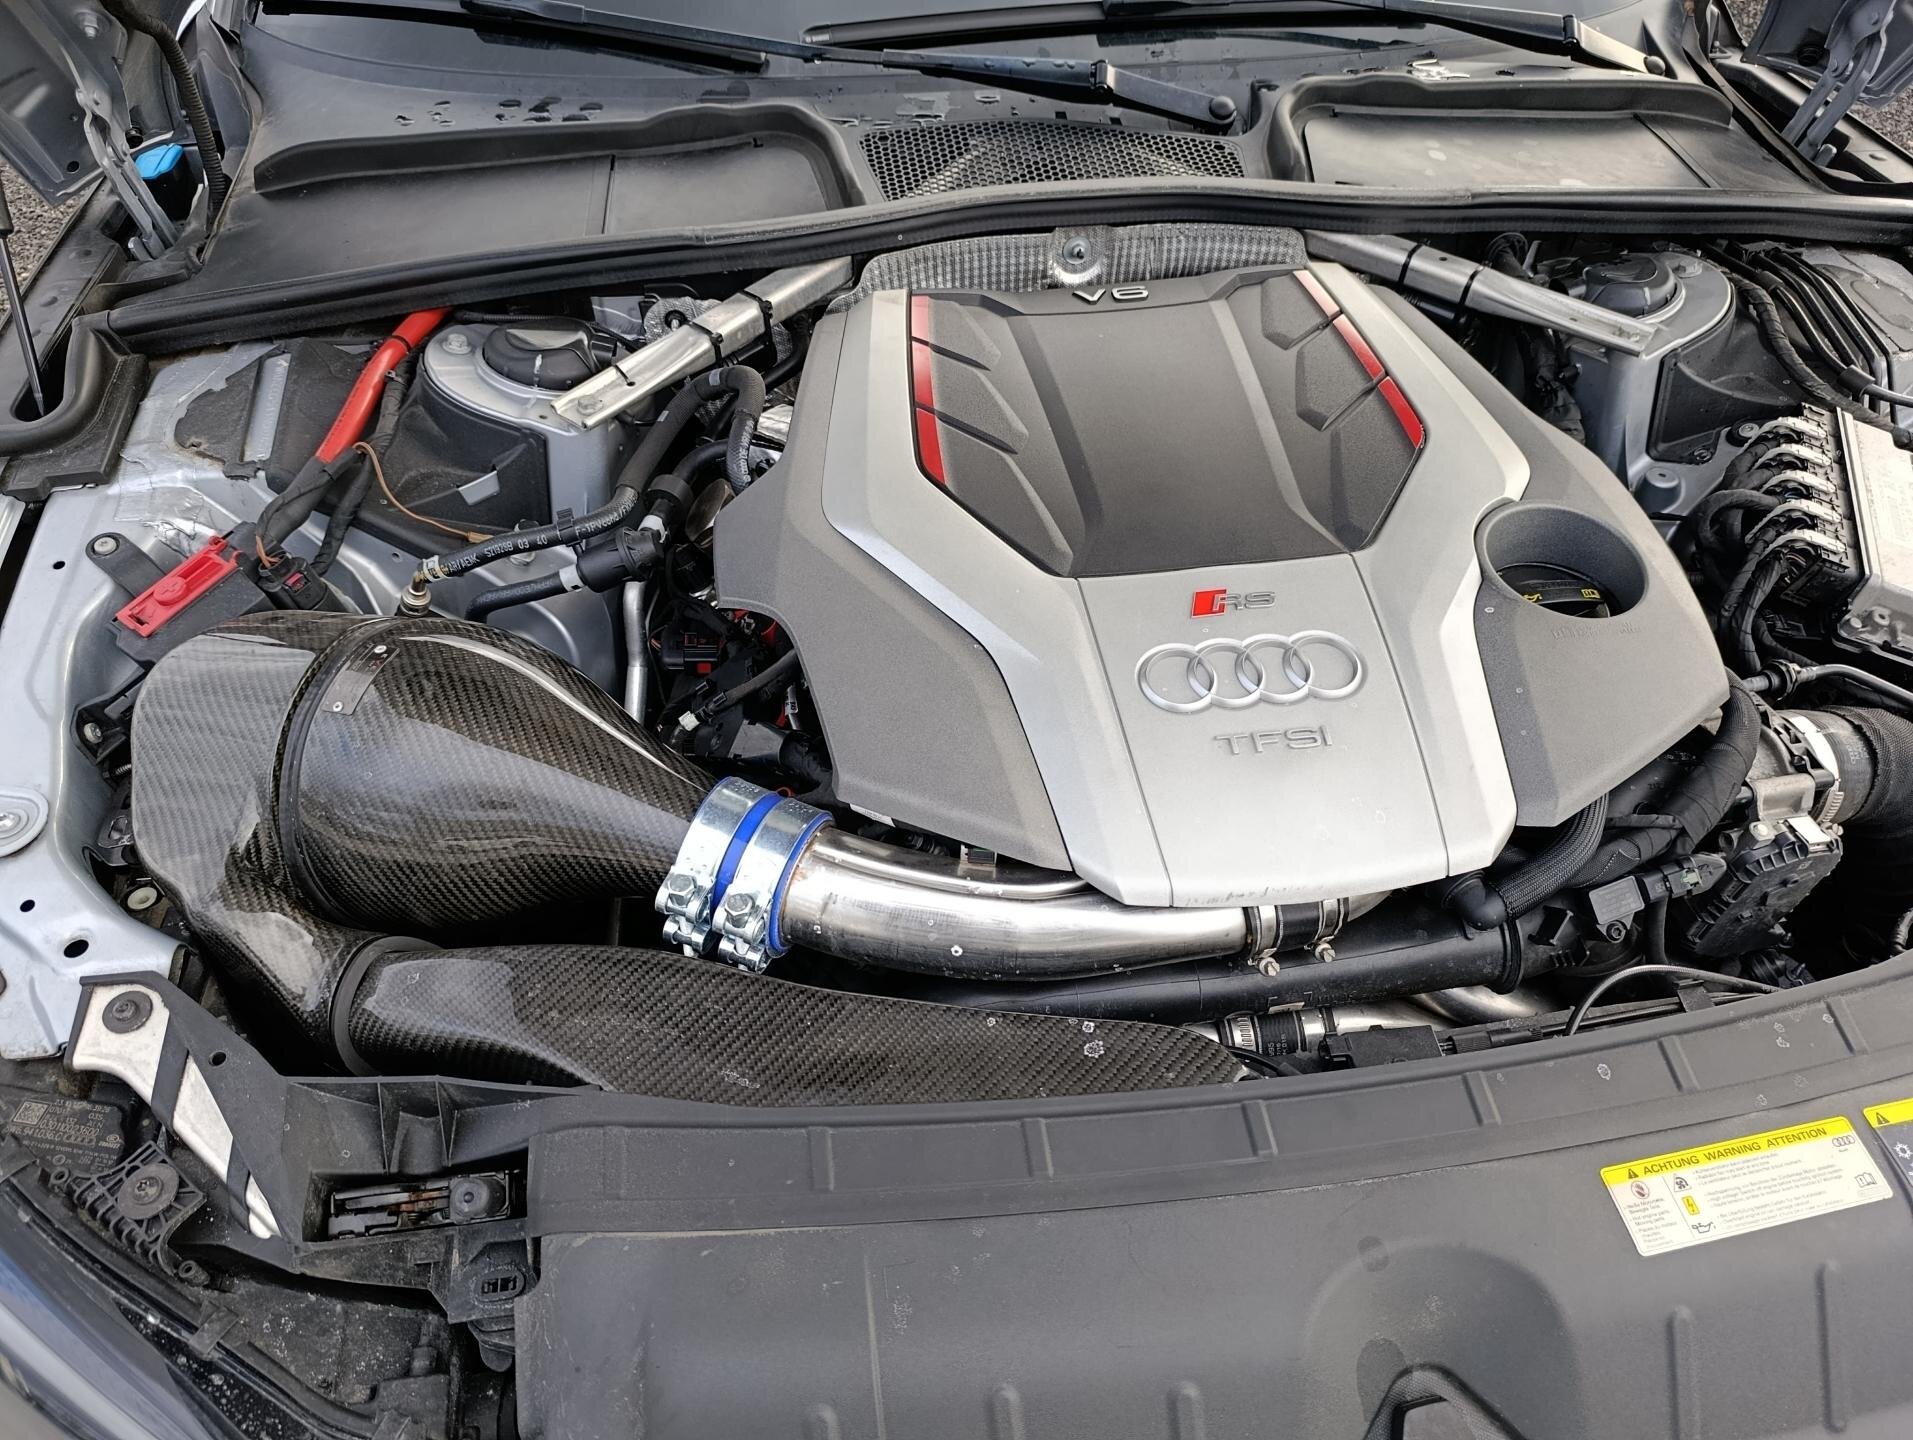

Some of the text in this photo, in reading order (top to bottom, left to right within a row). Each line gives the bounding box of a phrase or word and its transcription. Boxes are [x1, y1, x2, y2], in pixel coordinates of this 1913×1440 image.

[1072, 285, 1149, 305] V6
[1210, 590, 1276, 612] RS
[1215, 725, 1333, 755] TFSI
[1643, 1155, 1700, 1175] ACHTUNG
[1704, 1141, 1761, 1161] WARNING
[1766, 1127, 1828, 1149] ATTENTION
